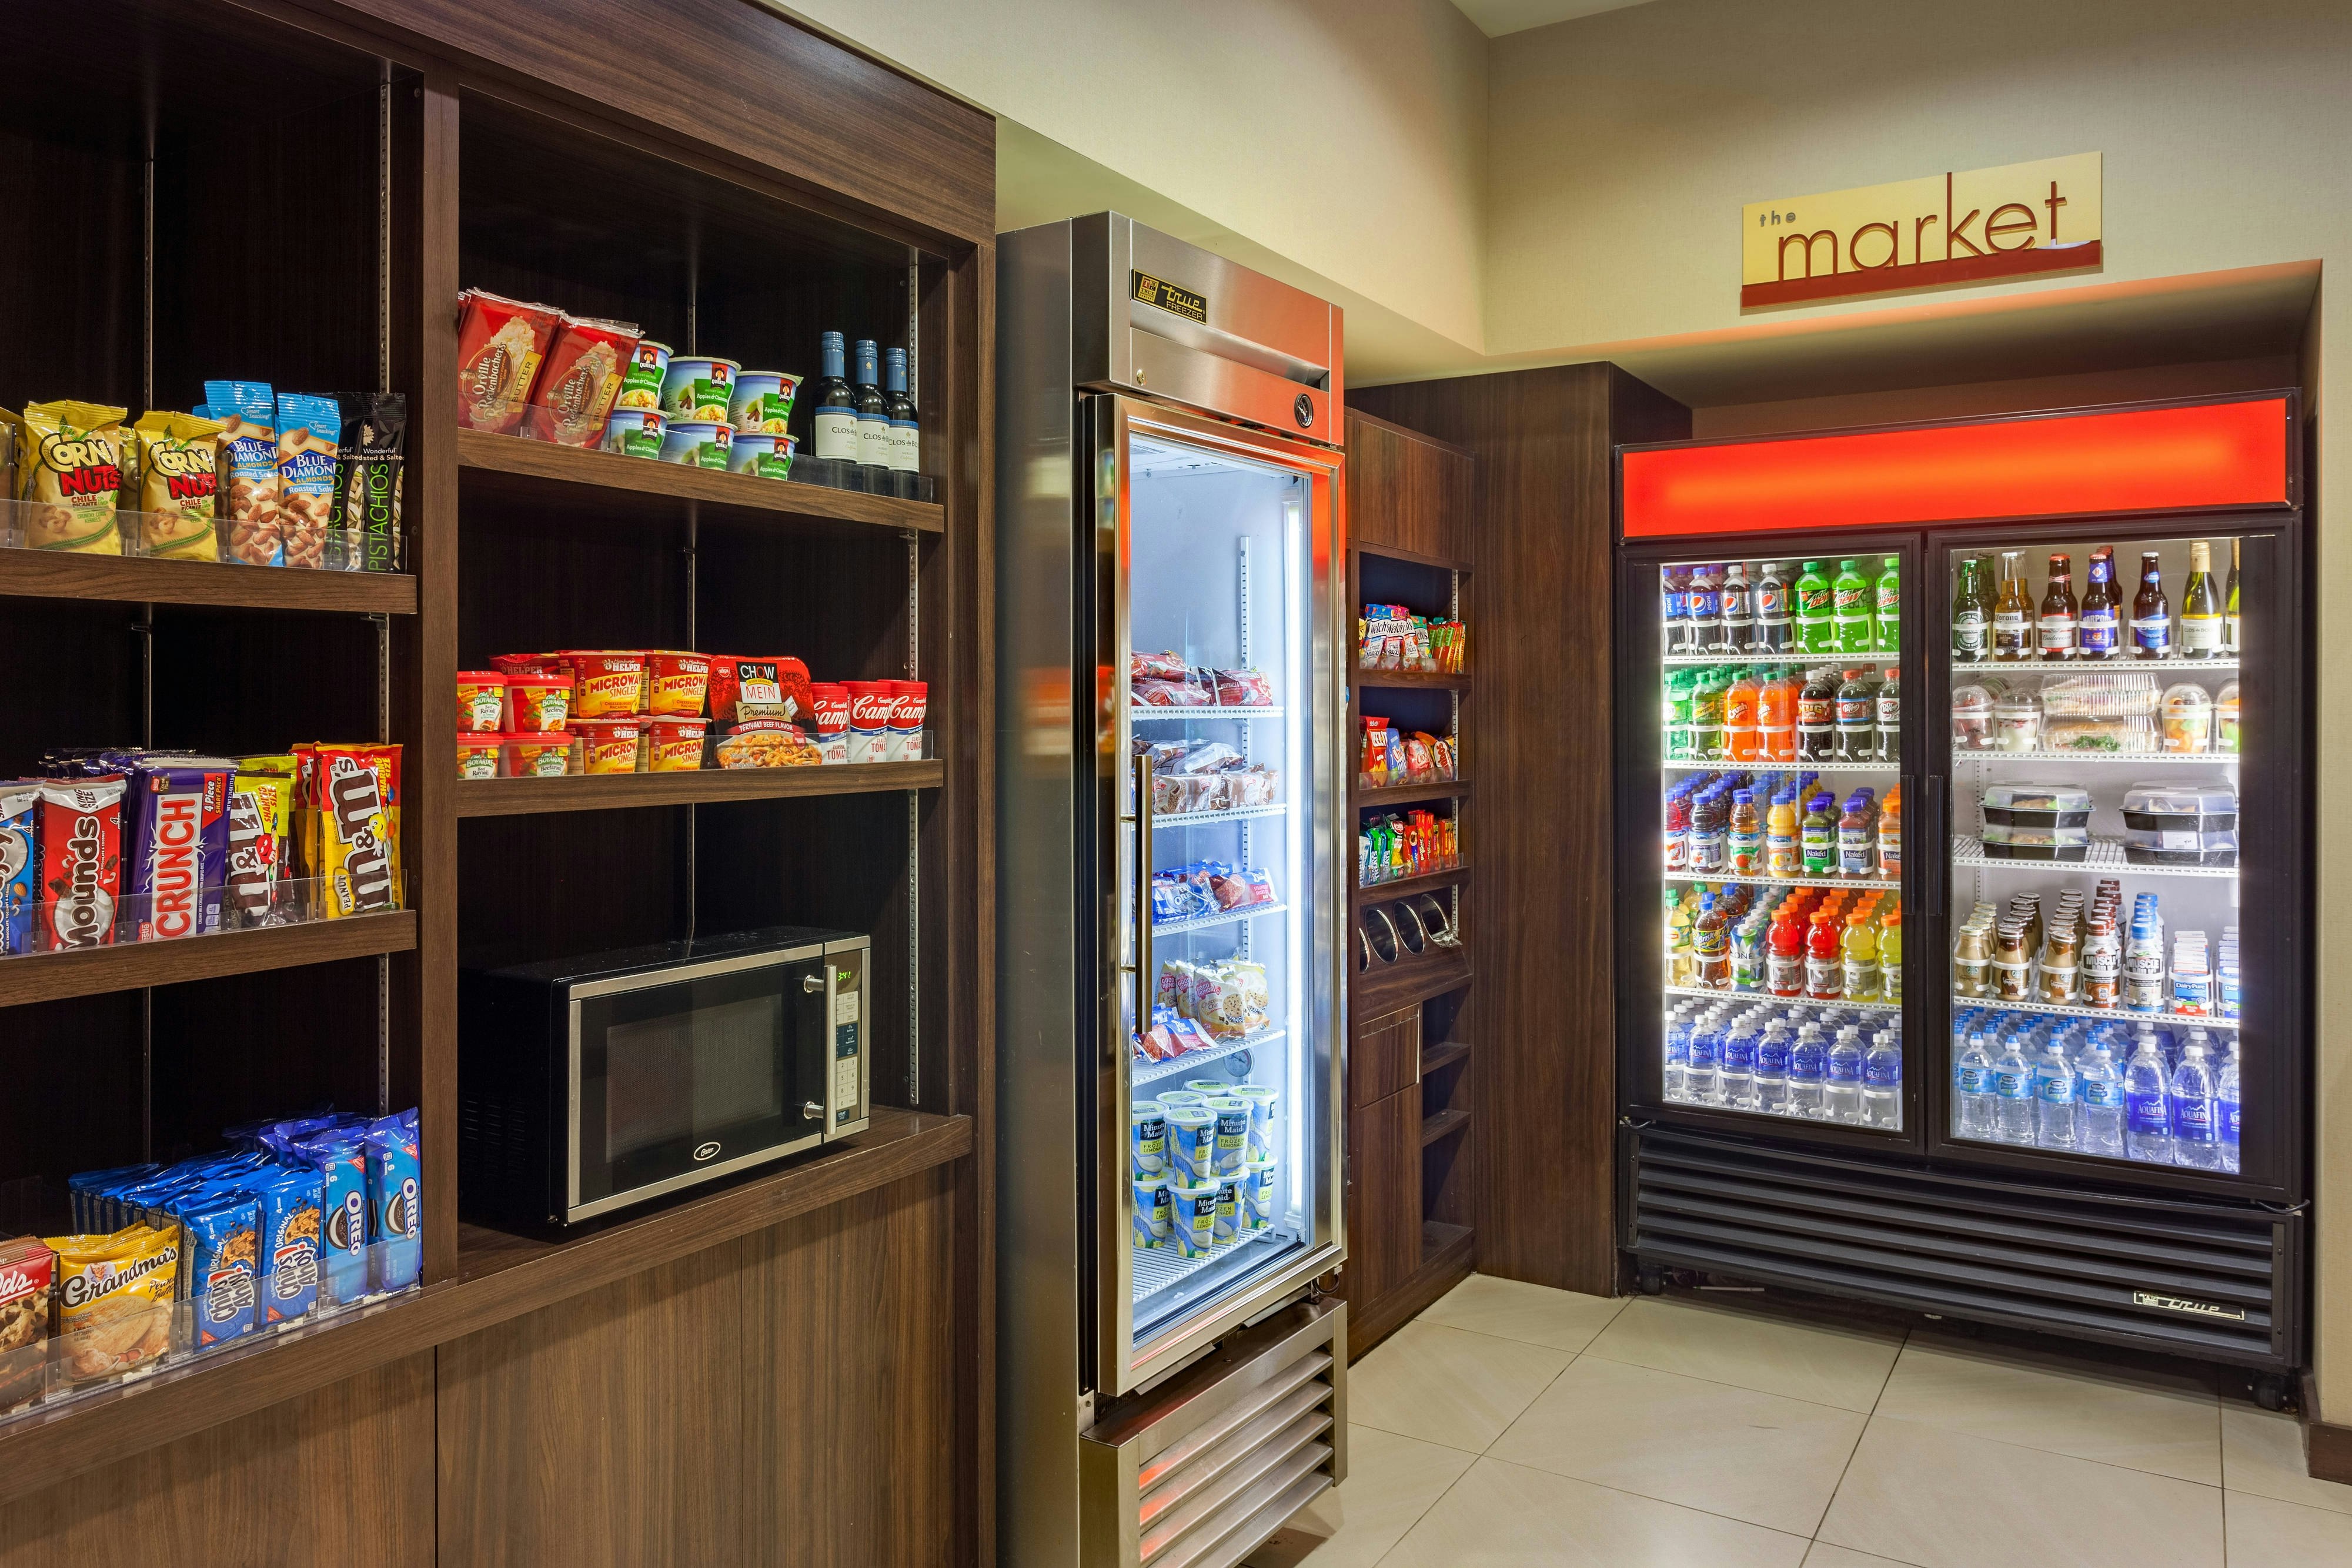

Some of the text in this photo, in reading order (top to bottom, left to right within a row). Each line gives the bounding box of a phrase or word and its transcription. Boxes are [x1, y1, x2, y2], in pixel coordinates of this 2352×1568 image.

[1760, 210, 1796, 227] the
[1779, 172, 2067, 282] market
[1161, 285, 1203, 313] true
[1166, 301, 1203, 320] FREEZER
[640, 362, 656, 370] QUAKER
[473, 357, 491, 395] Orville
[512, 362, 533, 403] BUTTER
[557, 379, 576, 414] Orville
[593, 382, 614, 422] BUTTER
[233, 440, 266, 452] BLUE
[626, 444, 641, 452] Apples
[39, 433, 113, 473] CORN
[149, 441, 214, 477] CORN
[237, 460, 274, 469] ALMONDS
[296, 454, 328, 467] BLUE
[230, 470, 259, 479] Roasted
[296, 475, 334, 484] ALMONDS
[289, 484, 319, 494] Roasted
[368, 464, 389, 571] PISTACHIOS
[1371, 621, 1389, 634] Welch's
[613, 663, 640, 672] HELPER
[740, 665, 775, 679] CHOW
[610, 687, 637, 698] SINGLES
[746, 686, 776, 699] MEIN
[475, 697, 500, 706] BOYARDEE
[740, 705, 786, 719] Premium
[1728, 703, 1748, 720] Crush
[1843, 704, 1859, 713] Pepper
[1883, 704, 1899, 713] Pepper
[739, 722, 762, 732] TERIYAKI
[775, 723, 793, 731] FLAVOR
[466, 758, 495, 767] BOYARDEE
[373, 757, 390, 797] SHARING SIZE
[75, 788, 85, 808] KING
[204, 781, 215, 813] 4 Piece
[258, 786, 271, 823] SHARING
[269, 786, 278, 808] SIZE
[110, 817, 118, 825] 4
[333, 758, 391, 912] m&m's
[155, 799, 196, 938] CRUNCH
[68, 816, 99, 948] Mounds
[338, 875, 352, 909] PEANUT
[2086, 955, 2117, 965] MUSCLE
[2128, 958, 2160, 969] MUSCLE
[1196, 983, 1210, 991] GOOD
[1198, 987, 1215, 996] HUMOR
[1689, 1048, 1712, 1058] AQUAFINA
[1725, 1051, 1748, 1061] AQUAFINA
[1759, 1057, 1783, 1065] AQUAFINA
[1793, 1062, 1817, 1072] AQUAFINA
[1829, 1065, 1853, 1075] AQUAFINA
[1866, 1069, 1890, 1080] AQUAFINA
[2137, 1104, 2167, 1116] AQUAFINA
[2180, 1108, 2212, 1121] AQUAFINA
[1143, 1122, 1165, 1133] Minute
[1221, 1118, 1245, 1127] Minute
[1147, 1129, 1163, 1138] Maid
[401, 1177, 417, 1239] OREO
[344, 1191, 362, 1256] OREO
[275, 1213, 293, 1248] ORIGINAL
[208, 1238, 228, 1272] ORIGINAL
[61, 1247, 177, 1308] Grandma's
[276, 1255, 302, 1299] Chips
[209, 1278, 237, 1323] Chips
